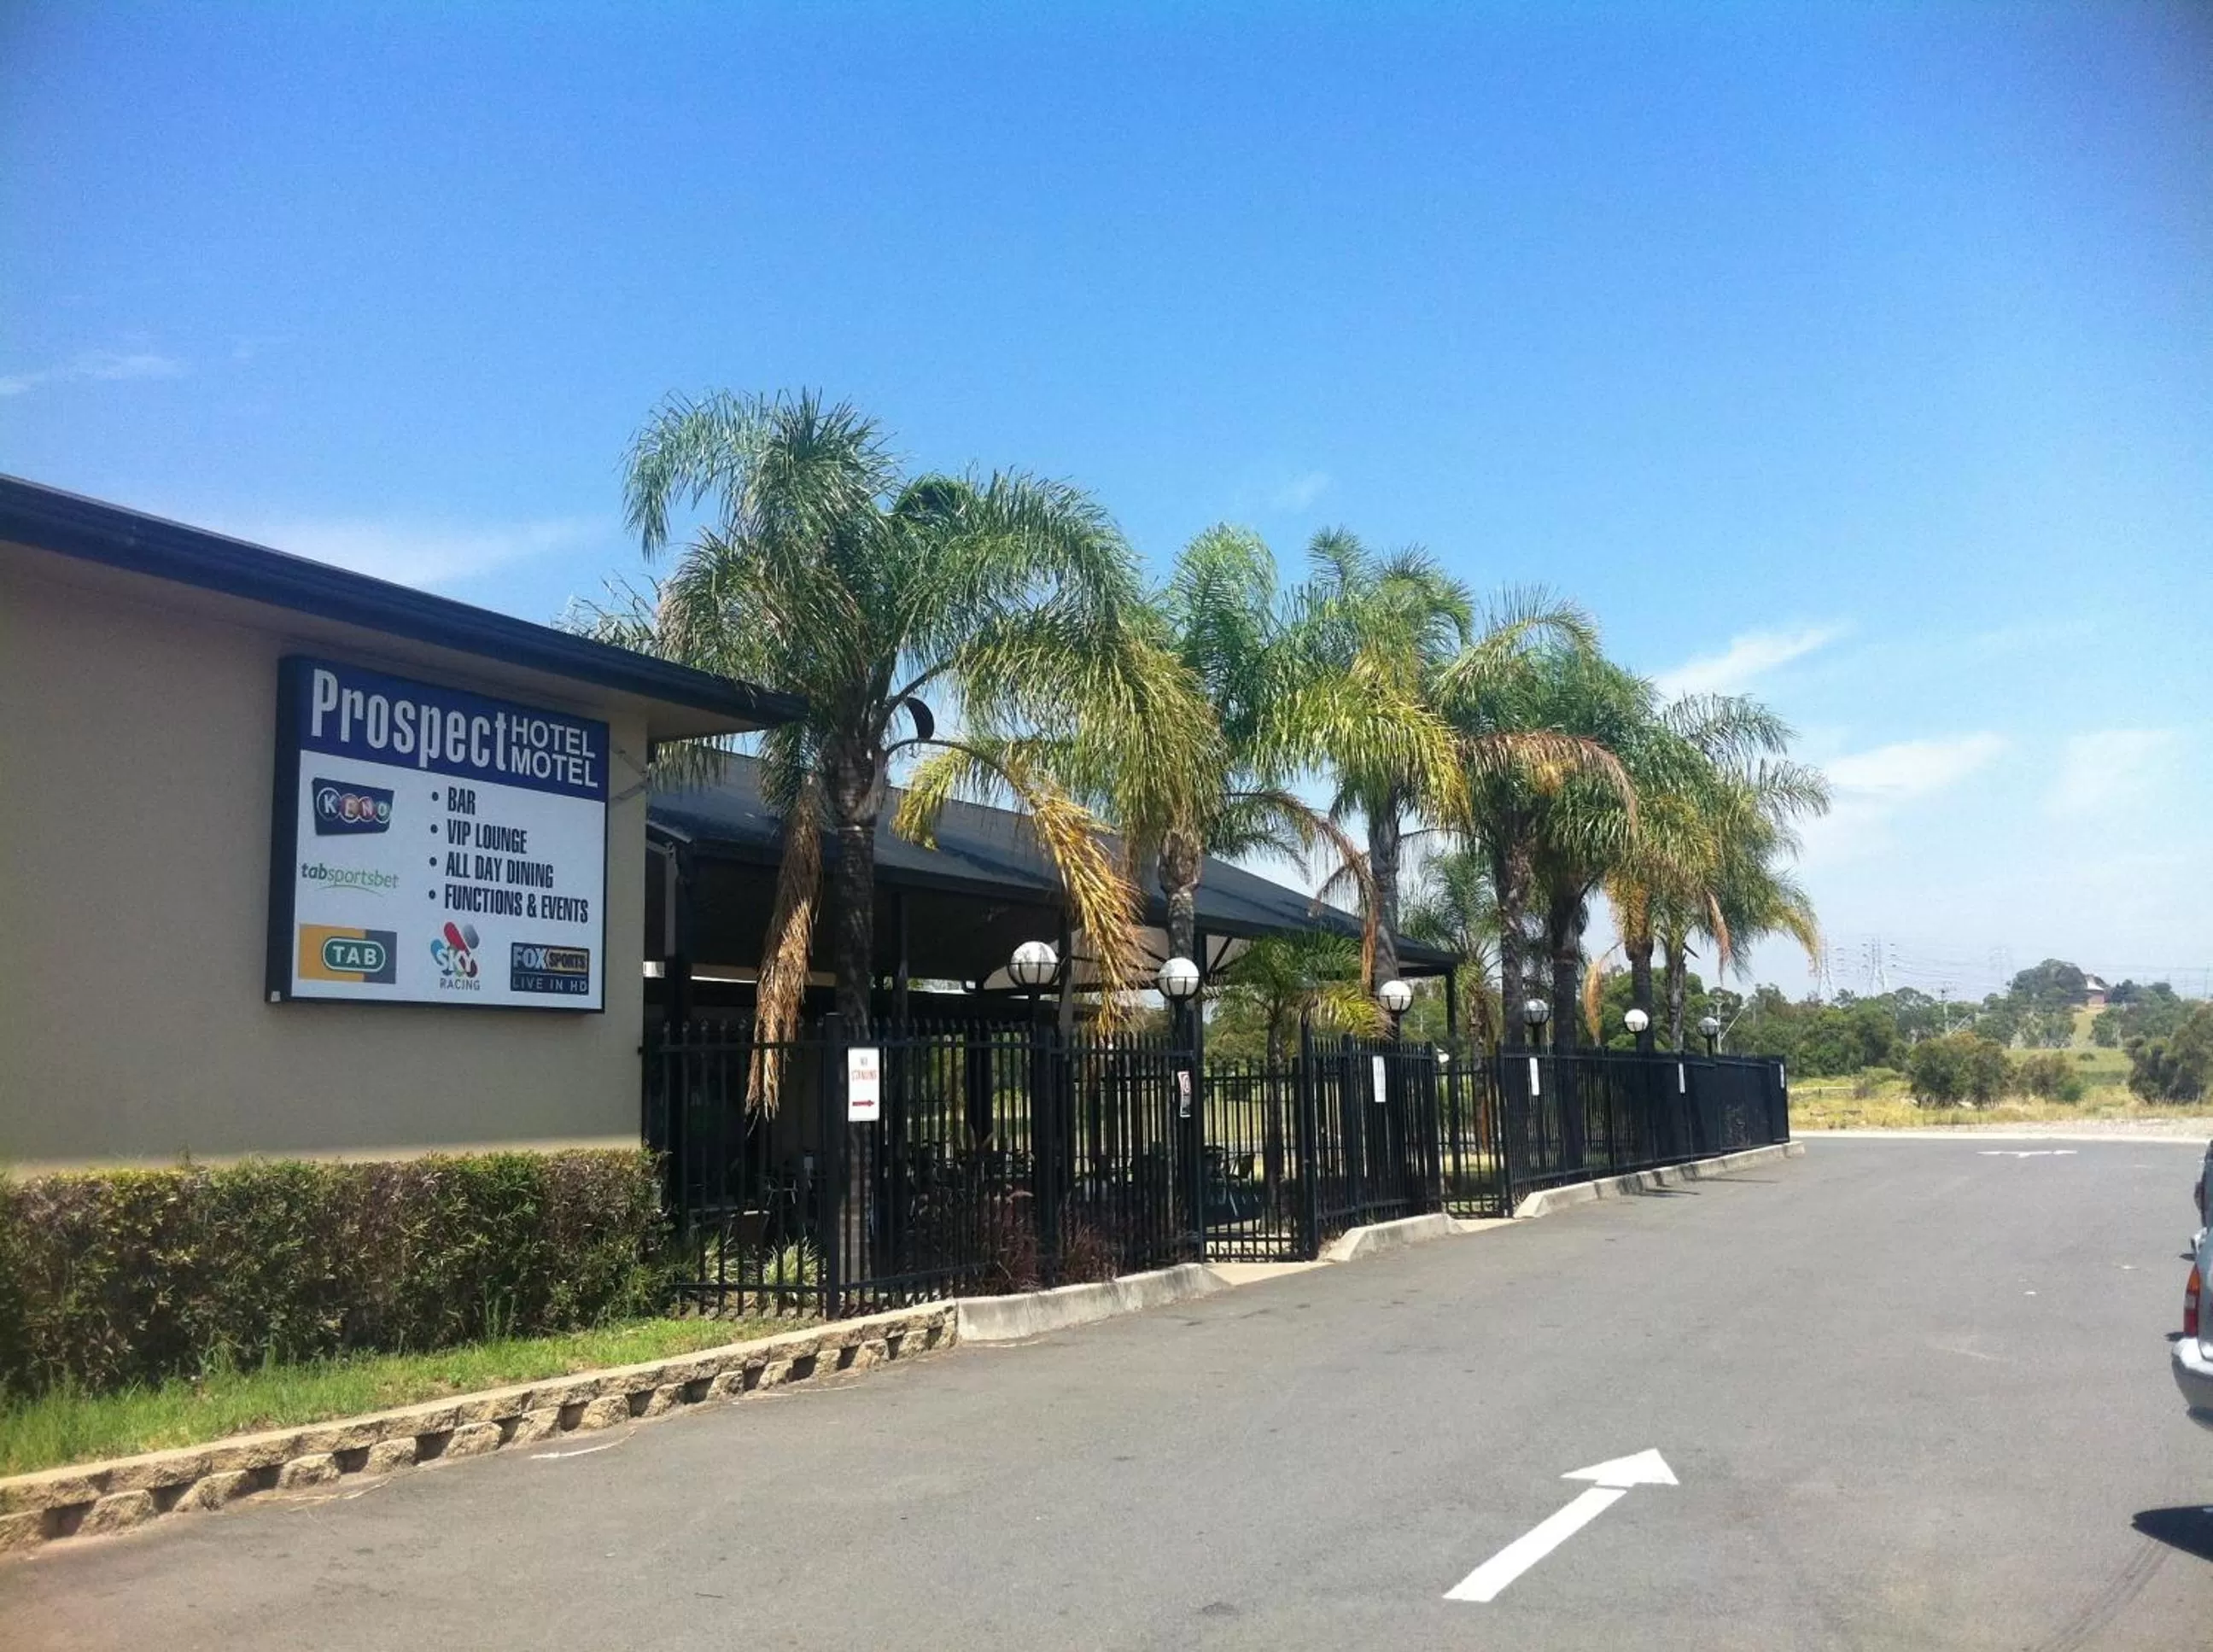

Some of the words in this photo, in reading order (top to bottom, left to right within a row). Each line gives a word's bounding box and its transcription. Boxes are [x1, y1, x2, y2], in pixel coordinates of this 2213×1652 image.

[311, 668, 506, 772] Prospect
[511, 715, 596, 759] HOTEL
[511, 745, 599, 788] MOTEL
[447, 785, 476, 815] BAR
[447, 819, 470, 846] VIP
[475, 823, 528, 854] LOUNGE
[301, 862, 400, 889] tabsportsbet
[445, 851, 470, 879] ALL
[475, 855, 503, 883] DAY
[506, 859, 554, 889] DINING
[444, 883, 523, 917] FUNCTIONS
[526, 893, 537, 919] &
[540, 895, 589, 924] EVENTS
[331, 945, 377, 966] TAB
[512, 946, 547, 970] FOX
[440, 977, 481, 990] RACING
[512, 976, 544, 990] LIVE
[550, 978, 563, 990] IN
[569, 979, 588, 992] HD
